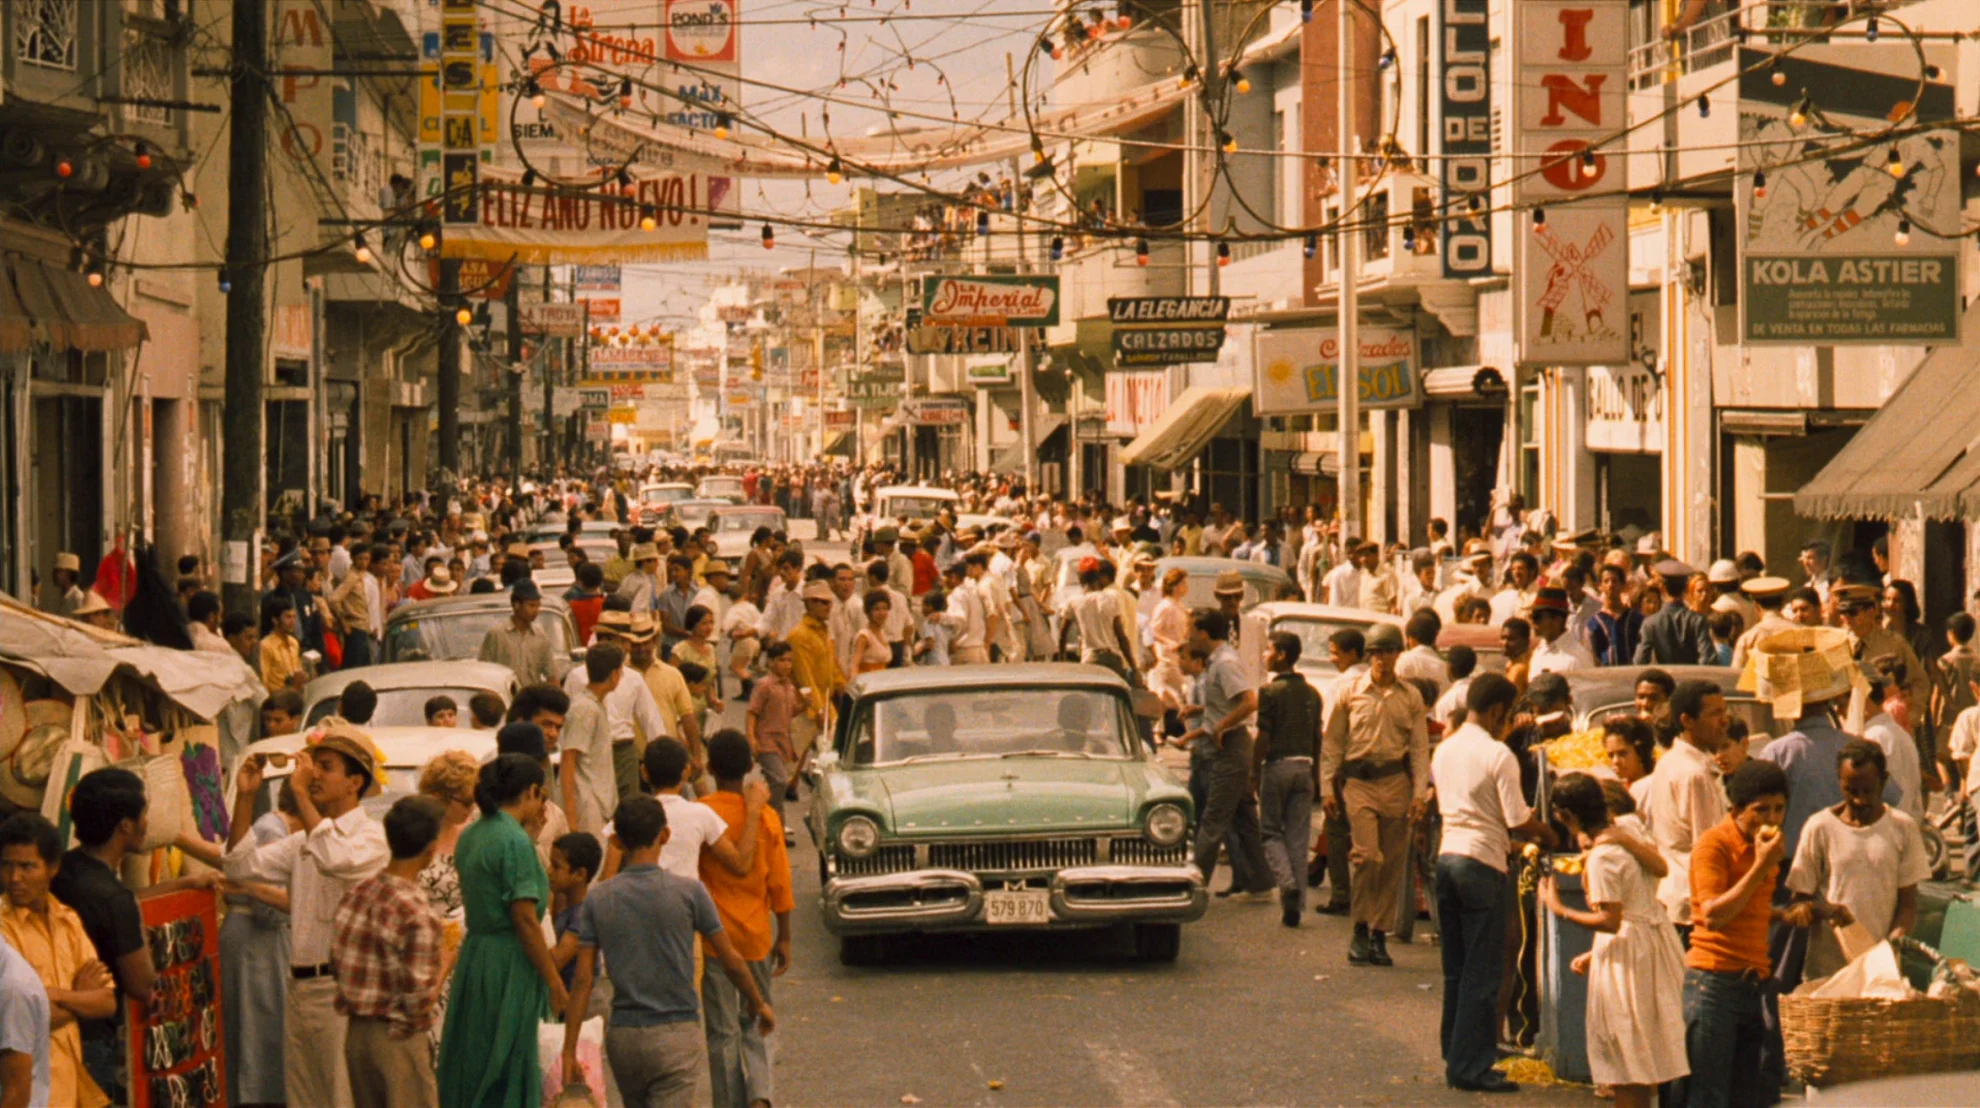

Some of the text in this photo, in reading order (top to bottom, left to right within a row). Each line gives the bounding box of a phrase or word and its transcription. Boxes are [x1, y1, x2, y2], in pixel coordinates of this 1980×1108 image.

[569, 5, 594, 32] La
[446, 0, 474, 86] ES
[567, 31, 656, 67] Sirena
[280, 9, 324, 161] MPO
[679, 85, 722, 102] MAX
[1540, 8, 1608, 191] INO
[513, 123, 555, 139] SIEM
[1445, 116, 1488, 142] DE
[482, 178, 533, 228] ELIZ
[600, 173, 699, 231] NUEVO!
[1446, 157, 1489, 271] ORO
[459, 263, 489, 274] ASA
[1753, 260, 1942, 285] KOLA ASTIER
[932, 279, 1047, 313] Imperial
[1113, 299, 1223, 320] LA ELEGANCIA
[1121, 331, 1217, 349] CALZADOS
[1753, 322, 1946, 335] DE VENTA EN TODAS LAS FARMACIAS
[1319, 335, 1411, 359] Czados
[1307, 364, 1409, 400] EL SOL
[1631, 375, 1648, 421] DE
[991, 900, 1044, 917] 579 870
